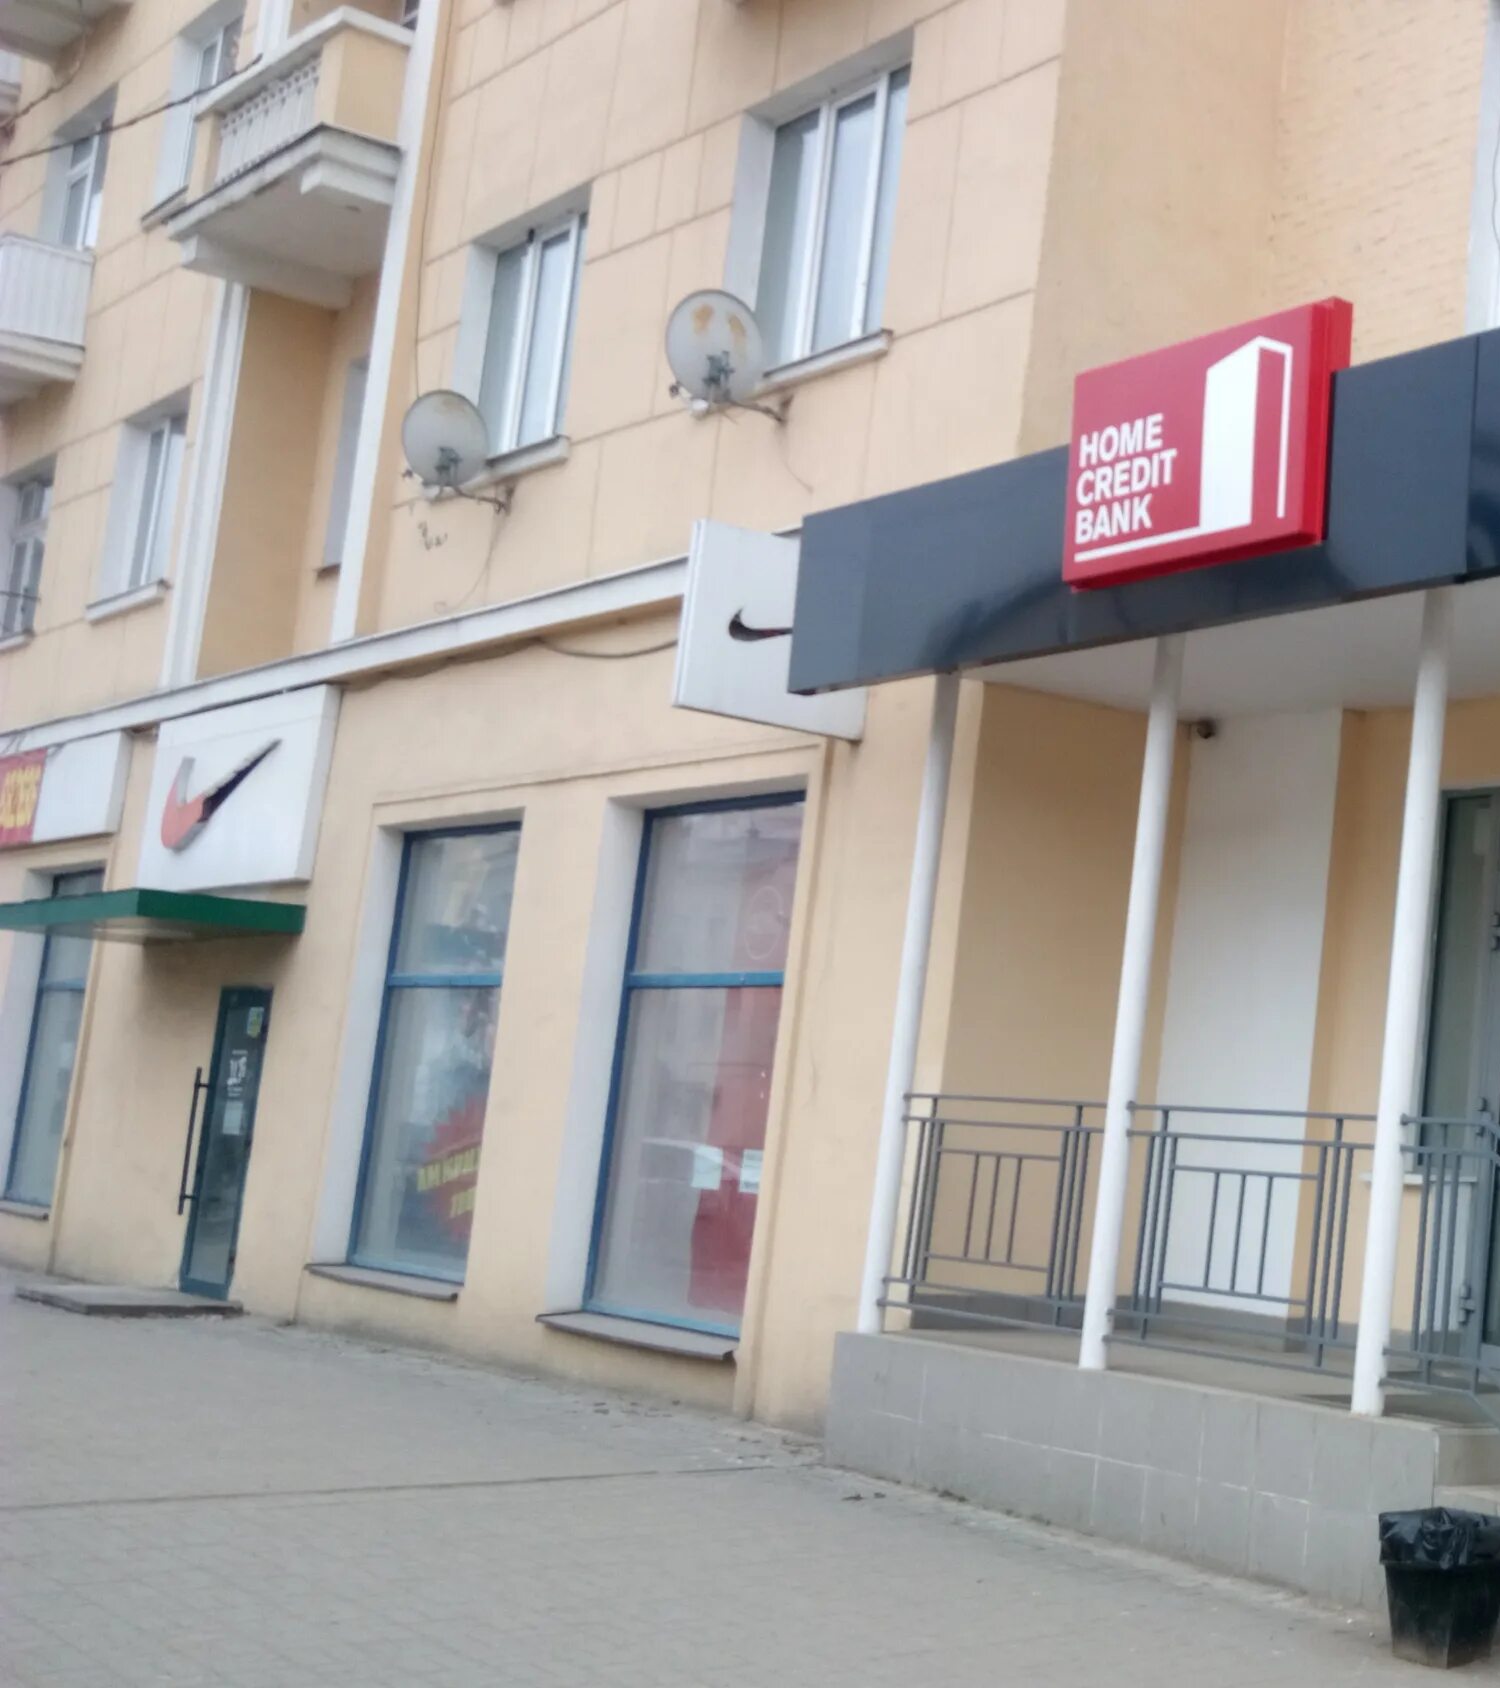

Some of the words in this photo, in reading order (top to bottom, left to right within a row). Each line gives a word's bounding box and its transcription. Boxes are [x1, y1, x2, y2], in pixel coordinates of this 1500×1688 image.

[1079, 412, 1164, 468] HOME
[1075, 447, 1178, 507] CREDIT
[1074, 492, 1153, 544] BANK
